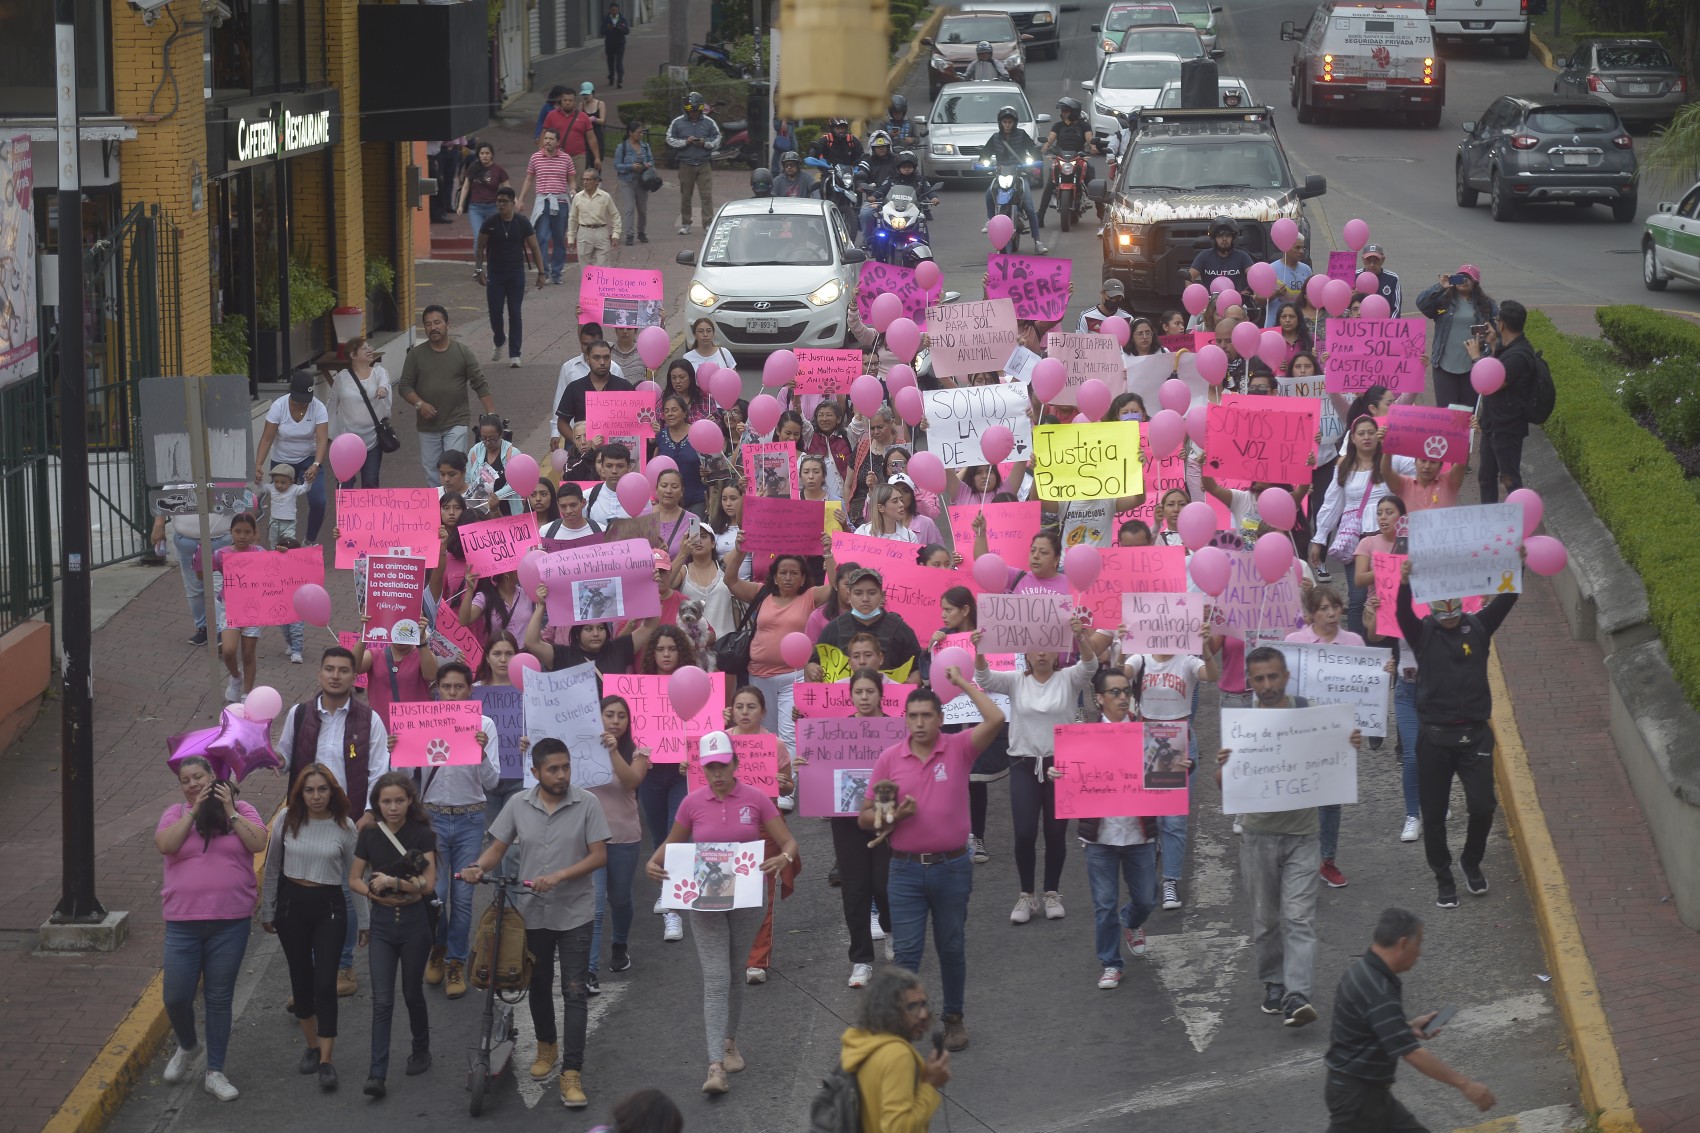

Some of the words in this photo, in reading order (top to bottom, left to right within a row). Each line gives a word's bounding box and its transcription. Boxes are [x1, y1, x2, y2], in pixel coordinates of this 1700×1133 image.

[238, 108, 277, 161] CAFETERÍA
[285, 110, 329, 151] RESTAURANTE
[596, 269, 609, 285] Por
[613, 277, 624, 286] los
[624, 280, 636, 288] que
[864, 265, 887, 287] NO
[926, 301, 997, 323] #JUSTICIA
[945, 322, 968, 331] PARA
[973, 317, 993, 329] SOL
[1336, 321, 1410, 338] JUSTICIA
[930, 334, 955, 348] #NO
[959, 336, 971, 347] AL
[973, 332, 1015, 346] MALTRATO
[1094, 338, 1113, 350] PARA
[1332, 343, 1354, 352] PARA
[1364, 339, 1401, 357] SOL
[847, 353, 861, 362] SOL
[957, 348, 998, 362] ANIMAL
[1074, 349, 1088, 360] SOL
[817, 366, 845, 375] Maltrato
[1072, 361, 1081, 373] AL
[1083, 361, 1119, 373] MALTRATO
[1330, 358, 1384, 375] CASTIGO
[1395, 360, 1411, 374] AL
[806, 376, 841, 384] ANIMAL
[1343, 374, 1399, 389] ASESINO
[1295, 382, 1310, 398] NO
[586, 396, 627, 408] #JUSTICIA
[629, 399, 645, 408] PARA
[932, 385, 1007, 420] SOMOS
[607, 408, 629, 419] SOL
[958, 419, 979, 439] LA
[1208, 406, 1273, 440] SOMOS
[1283, 413, 1307, 442] LA
[942, 441, 968, 465] DE
[1038, 431, 1118, 468] Justicia
[1233, 439, 1269, 461] VOZ
[1280, 442, 1299, 465] DE
[1036, 470, 1076, 498] Para
[1078, 457, 1128, 497] Sol
[1495, 503, 1517, 522] SER
[338, 513, 362, 533] #NO
[366, 512, 375, 531] al
[383, 511, 431, 534] Maltrato
[509, 523, 532, 544] Para
[886, 543, 903, 559] Para
[385, 564, 418, 572] animales
[558, 565, 571, 577] No
[574, 564, 582, 575] al
[583, 558, 622, 574] Maltrato
[1130, 551, 1164, 574] LAS
[398, 572, 416, 580] Dios.
[379, 581, 419, 590] bestialidad
[382, 590, 415, 599] humana.
[1133, 596, 1151, 614] No
[1156, 596, 1170, 615] al
[1139, 609, 1200, 632] maltrato
[1226, 606, 1295, 629] ANIMAL
[992, 624, 1034, 647] PARA
[1040, 624, 1070, 648] SOL
[1146, 633, 1191, 650] animal
[1318, 648, 1382, 667] ASESINADA
[617, 676, 648, 696] QUE
[1328, 684, 1370, 693] FISCALIA
[1351, 675, 1380, 685] 05/23
[555, 699, 595, 723] estrellas
[392, 721, 405, 732] NO
[407, 721, 416, 730] AL
[419, 717, 457, 729] MALTRATO
[704, 718, 713, 731] A
[818, 721, 858, 741] Justicia
[859, 720, 881, 740] Para
[885, 721, 907, 740] Sol
[1262, 728, 1273, 738] de
[817, 746, 831, 761] No
[834, 746, 844, 760] al
